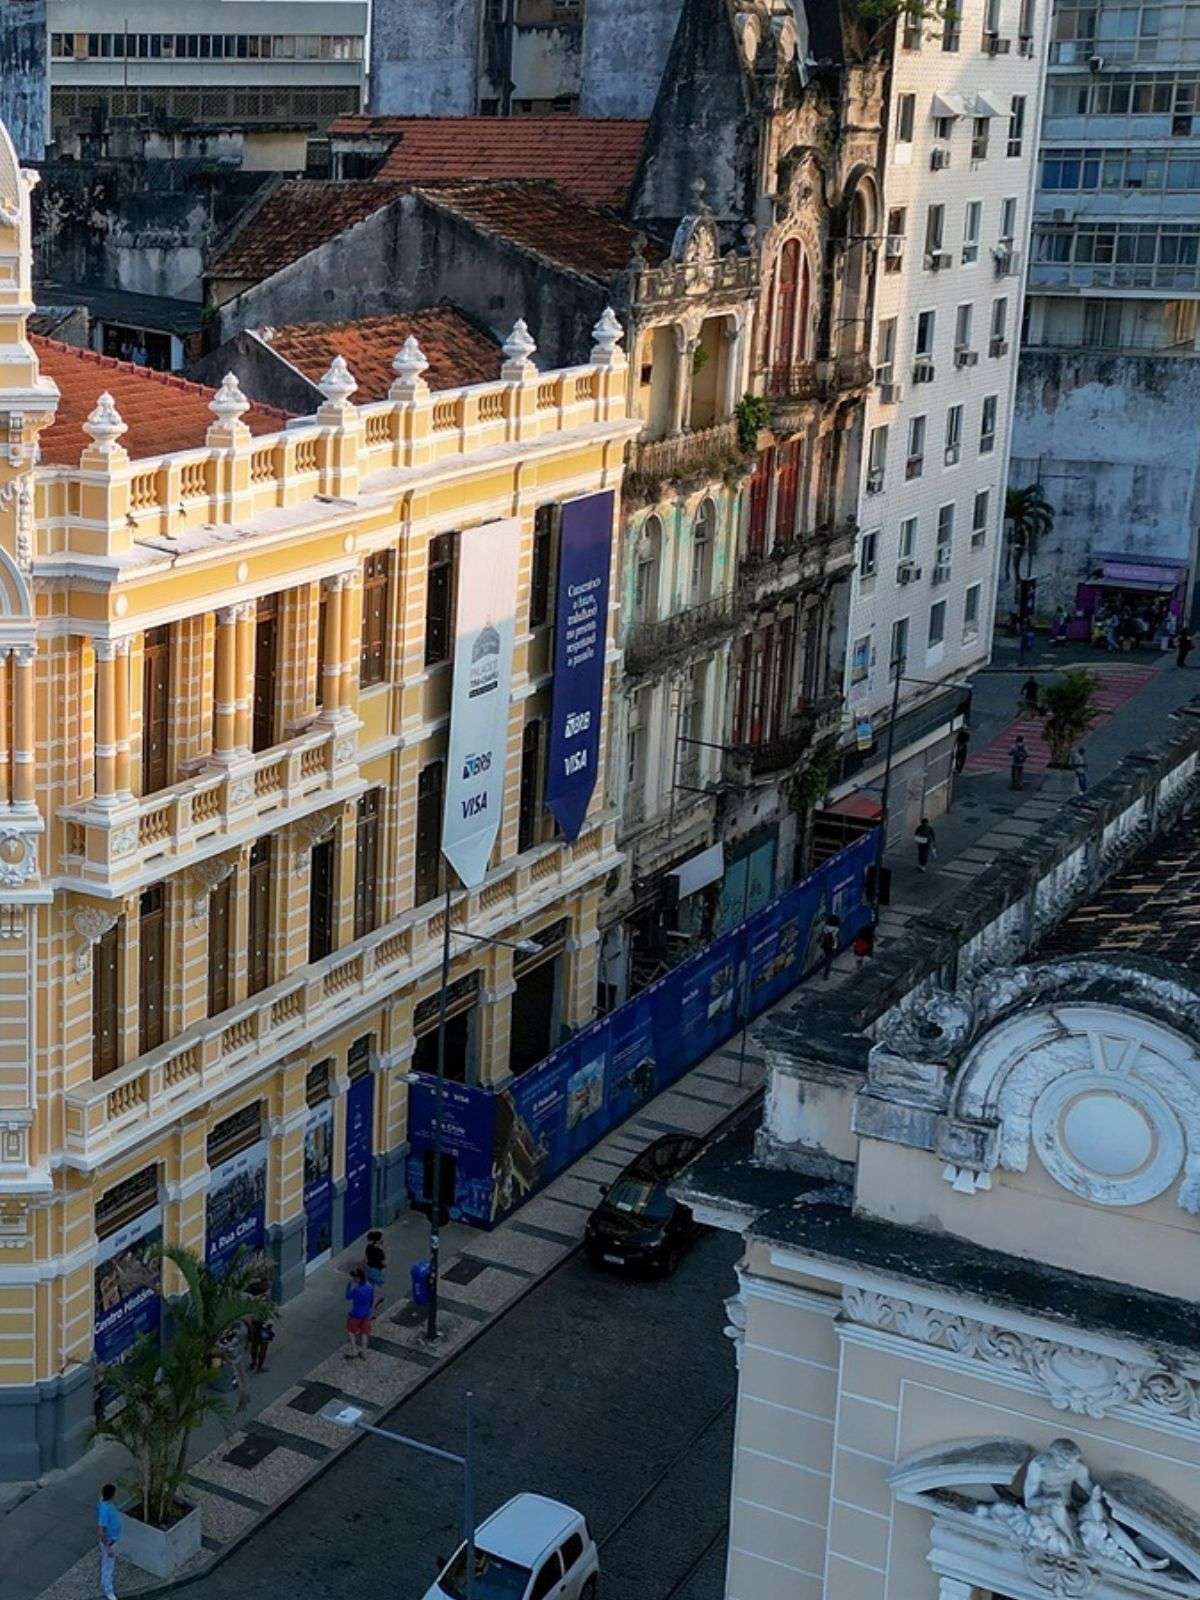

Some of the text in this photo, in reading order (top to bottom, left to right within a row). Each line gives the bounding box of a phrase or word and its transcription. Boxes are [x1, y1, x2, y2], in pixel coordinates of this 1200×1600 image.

[564, 749, 588, 777] VISA
[460, 791, 487, 820] VISA
[94, 1308, 124, 1335] Centro
